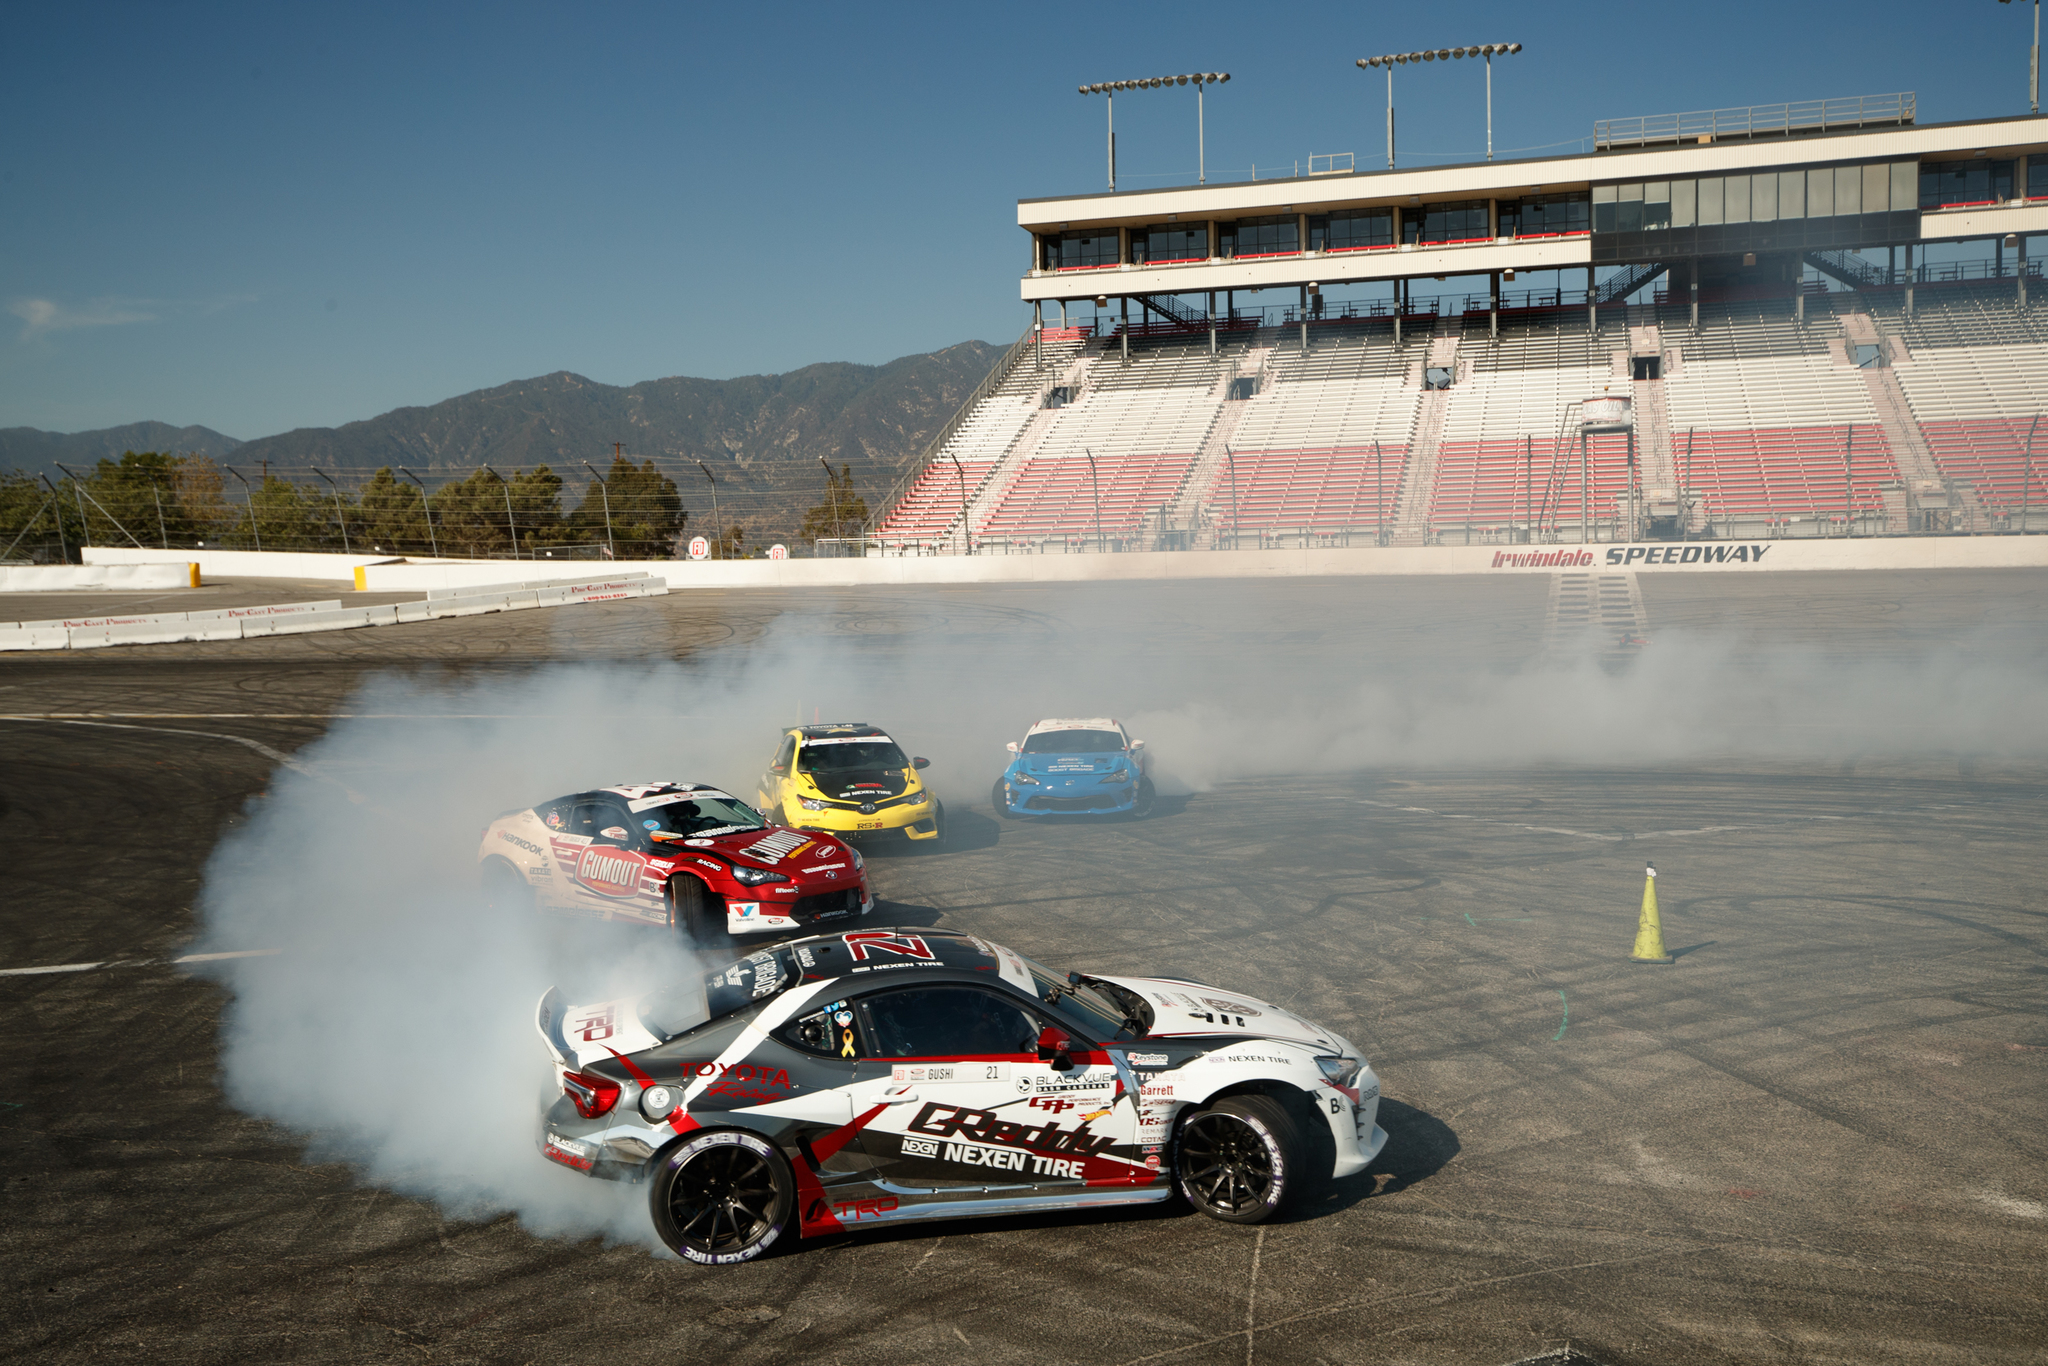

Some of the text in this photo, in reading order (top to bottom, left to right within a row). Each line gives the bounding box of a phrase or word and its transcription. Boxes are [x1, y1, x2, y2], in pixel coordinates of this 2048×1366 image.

[1606, 545, 1771, 566] SPEEDWAY
[581, 850, 641, 888] GUMOUT
[697, 858, 722, 872] RACING
[873, 962, 914, 971] NEXEN
[574, 1005, 615, 1042] TRD
[1136, 1053, 1167, 1061] Keystone
[1228, 1055, 1265, 1063] NEXEN
[1268, 1056, 1292, 1065] TIRE
[679, 1061, 791, 1090] TOYOTA
[928, 1068, 954, 1080] GUSHI
[986, 1066, 999, 1080] 21
[1036, 1072, 1111, 1085] BLACKVUE
[706, 1081, 789, 1106] Racing
[1140, 1084, 1174, 1096] Garrett
[944, 1142, 1026, 1172] NEXEN
[1031, 1153, 1086, 1180] TIRE
[833, 1196, 899, 1220] TRD
[684, 1243, 761, 1265] NEXEN TIRE
